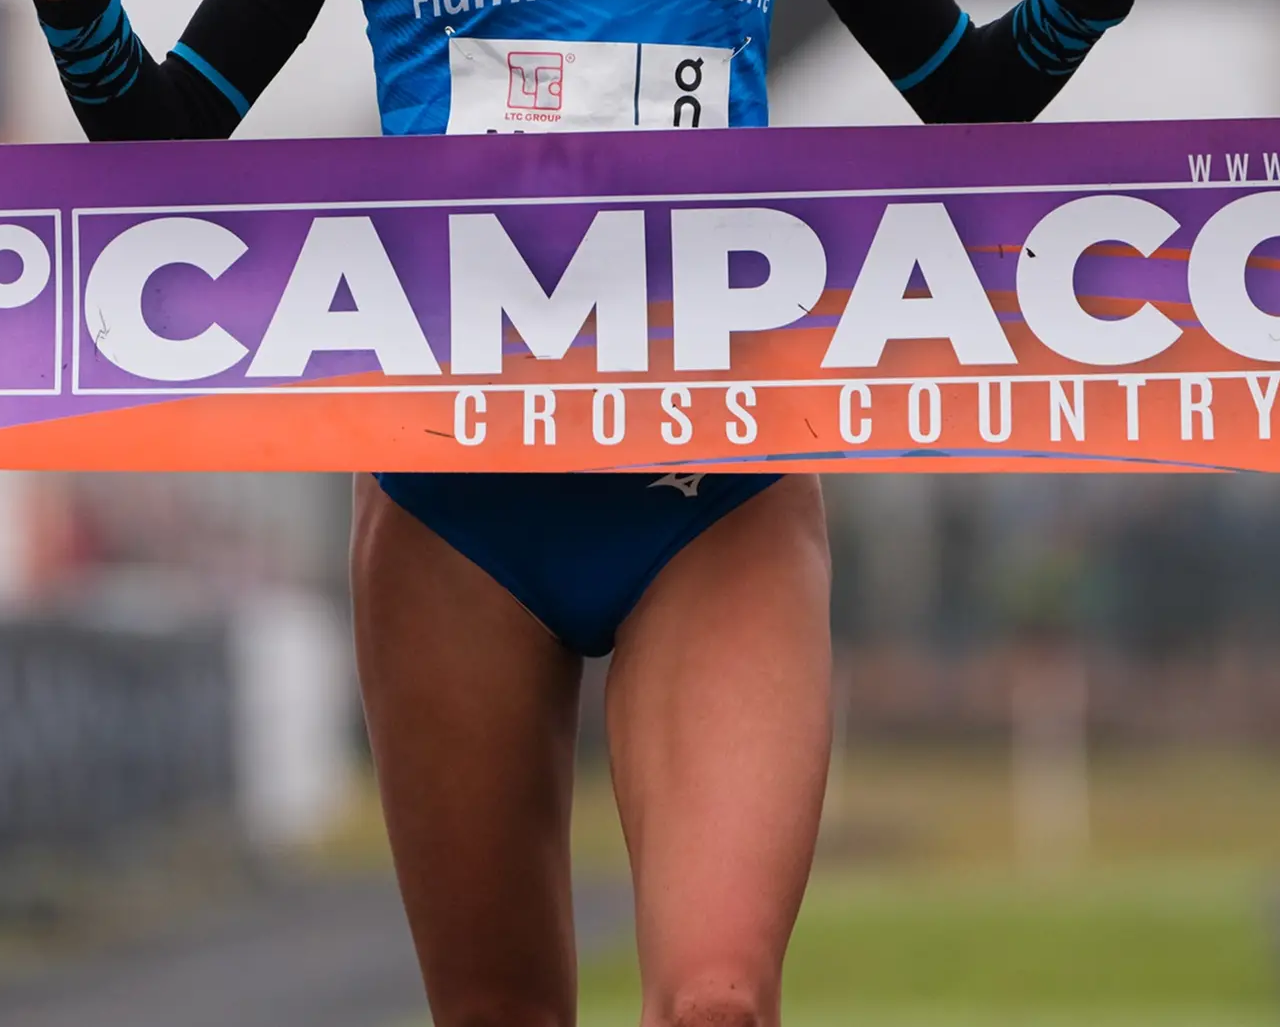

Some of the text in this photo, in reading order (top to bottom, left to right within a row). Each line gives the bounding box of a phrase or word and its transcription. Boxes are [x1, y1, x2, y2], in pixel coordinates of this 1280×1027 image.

[504, 112, 562, 123] LTC GROUP
[453, 383, 758, 446] CROSS
